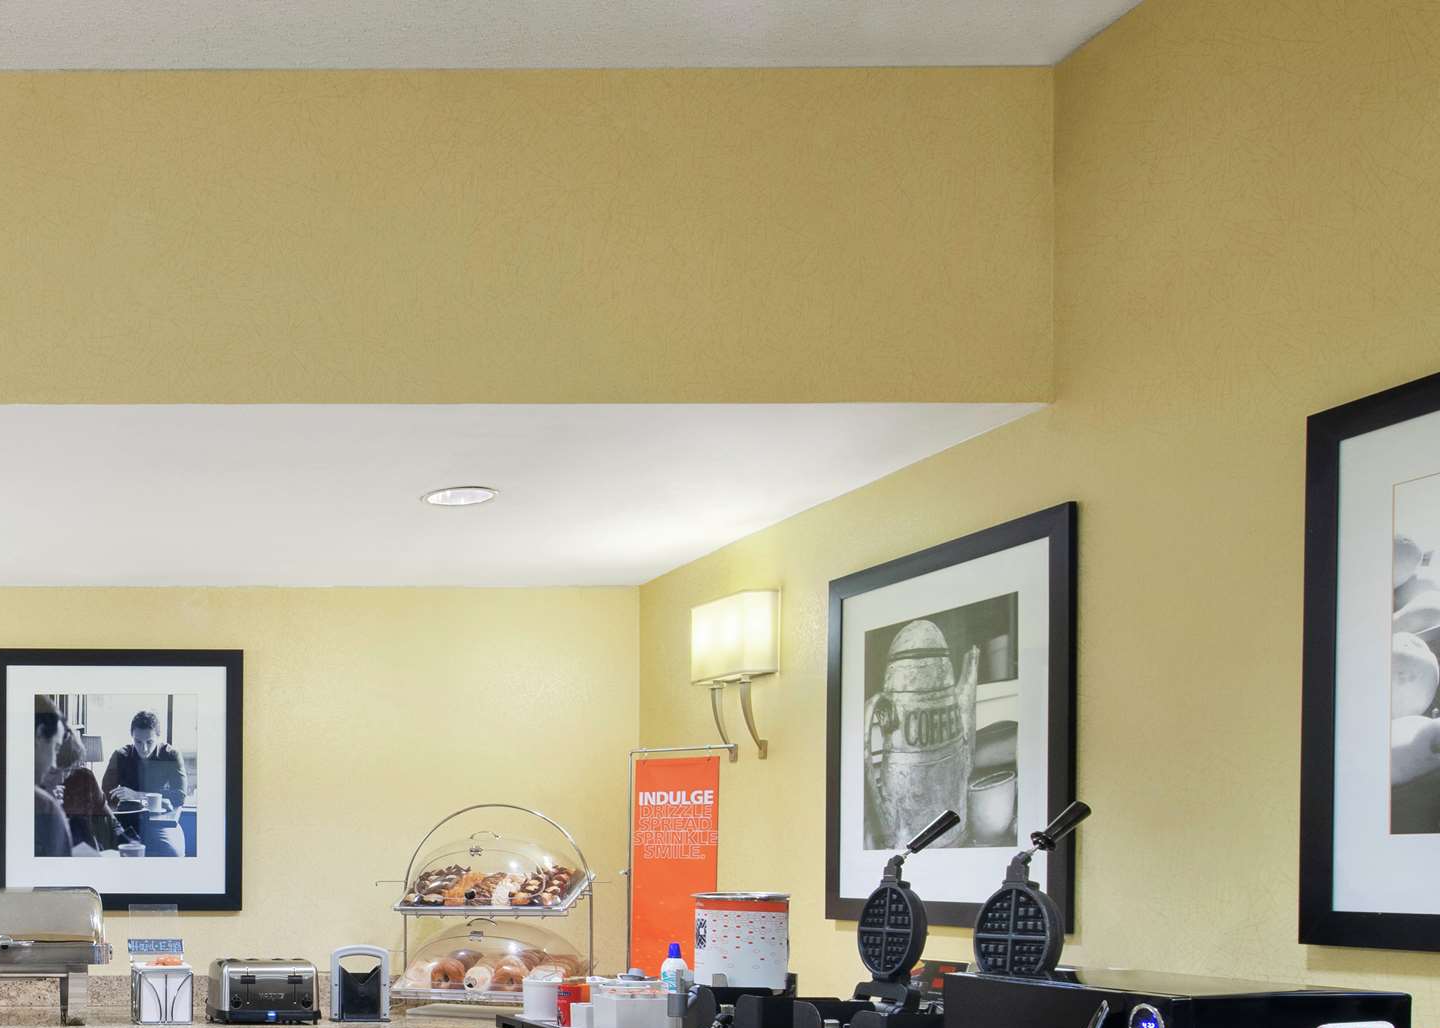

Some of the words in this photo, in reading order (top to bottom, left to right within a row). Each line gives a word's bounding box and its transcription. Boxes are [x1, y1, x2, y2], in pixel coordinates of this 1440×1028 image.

[639, 790, 714, 806] INDULGE
[641, 804, 713, 818] DRIZZLE
[640, 816, 713, 832] SPREAD
[633, 830, 720, 846] SPRINKLE
[643, 844, 706, 859] SMILE.
